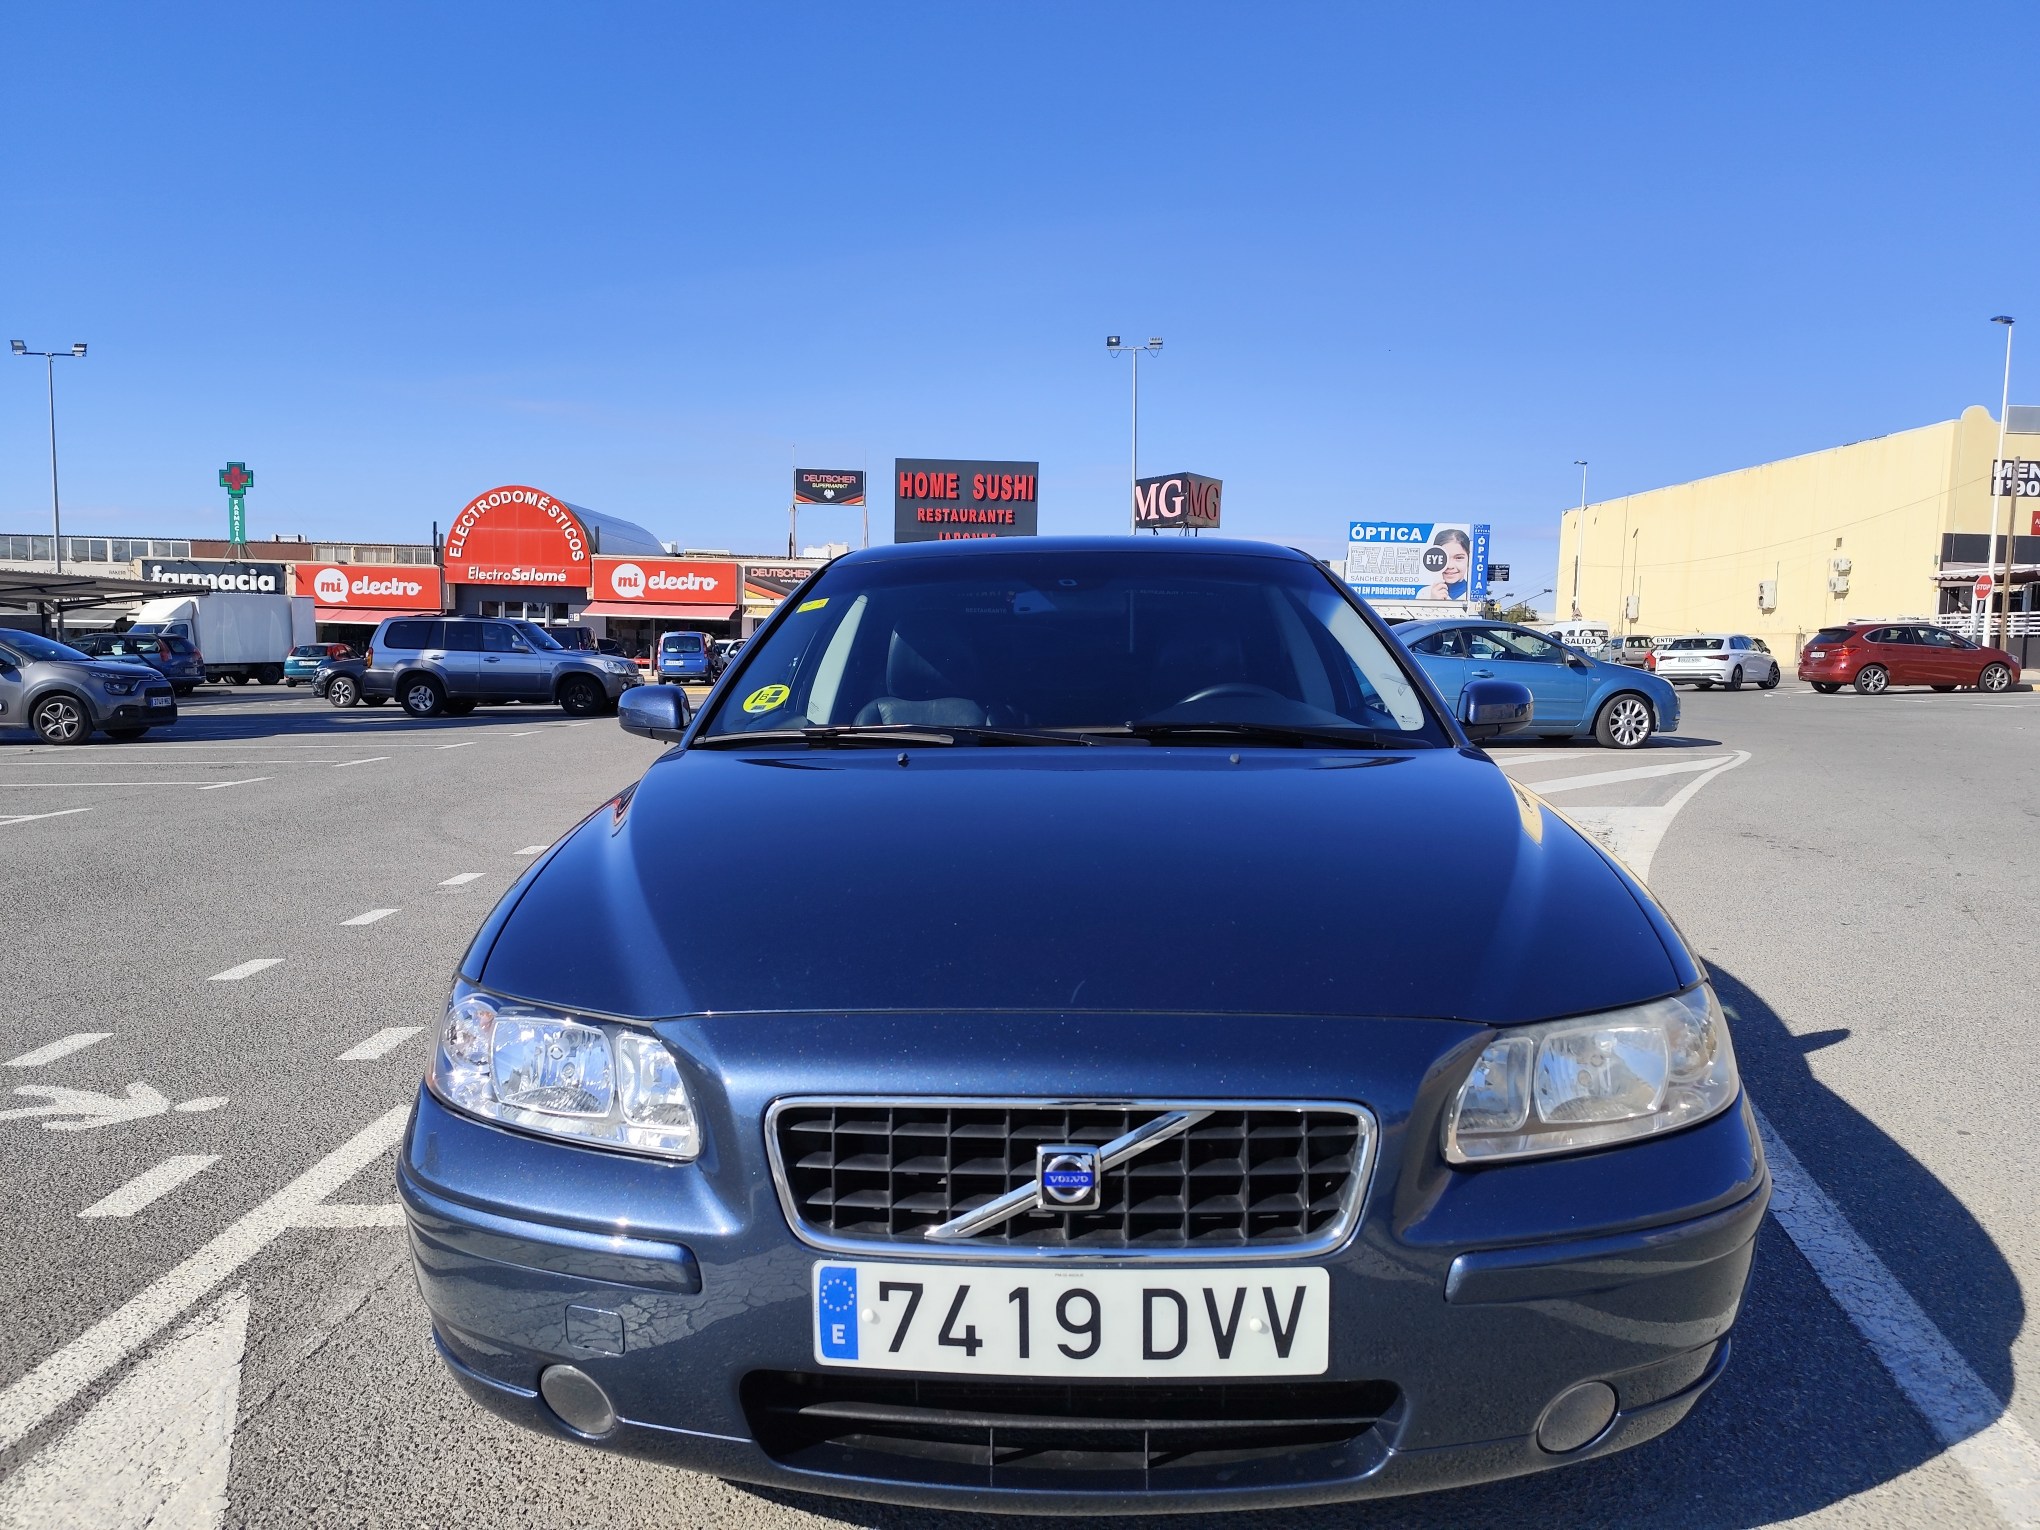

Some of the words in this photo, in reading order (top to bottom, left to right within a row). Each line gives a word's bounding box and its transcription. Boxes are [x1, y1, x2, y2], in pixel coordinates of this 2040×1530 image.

[803, 474, 856, 484] DEUTSCHER
[899, 471, 958, 500] HOME
[973, 473, 1036, 502] SUSHI
[1135, 479, 1185, 521] MG
[1188, 479, 1220, 521] MG
[233, 499, 241, 542] FARMACIA
[917, 507, 1014, 525] RESTAURANTE
[449, 490, 585, 562] ELECTRODOMÉSTICOS
[1350, 524, 1422, 541] ÓPTICA
[1426, 554, 1444, 566] EYE
[151, 565, 276, 591] farmacia
[617, 573, 640, 588] mi
[648, 571, 719, 591] electro
[750, 568, 811, 578] DEUTSCHER
[1350, 574, 1383, 582] SÁNCHEZ
[320, 577, 344, 593] mi
[351, 575, 423, 596] electro
[1361, 586, 1371, 594] EN
[1371, 587, 1416, 596] PROGRESIVOS
[1977, 583, 1991, 591] STOP
[1049, 1175, 1089, 1183] VOLVO
[832, 1322, 845, 1344] E
[879, 1281, 1101, 1360] 7419
[1141, 1286, 1308, 1360] DVV
